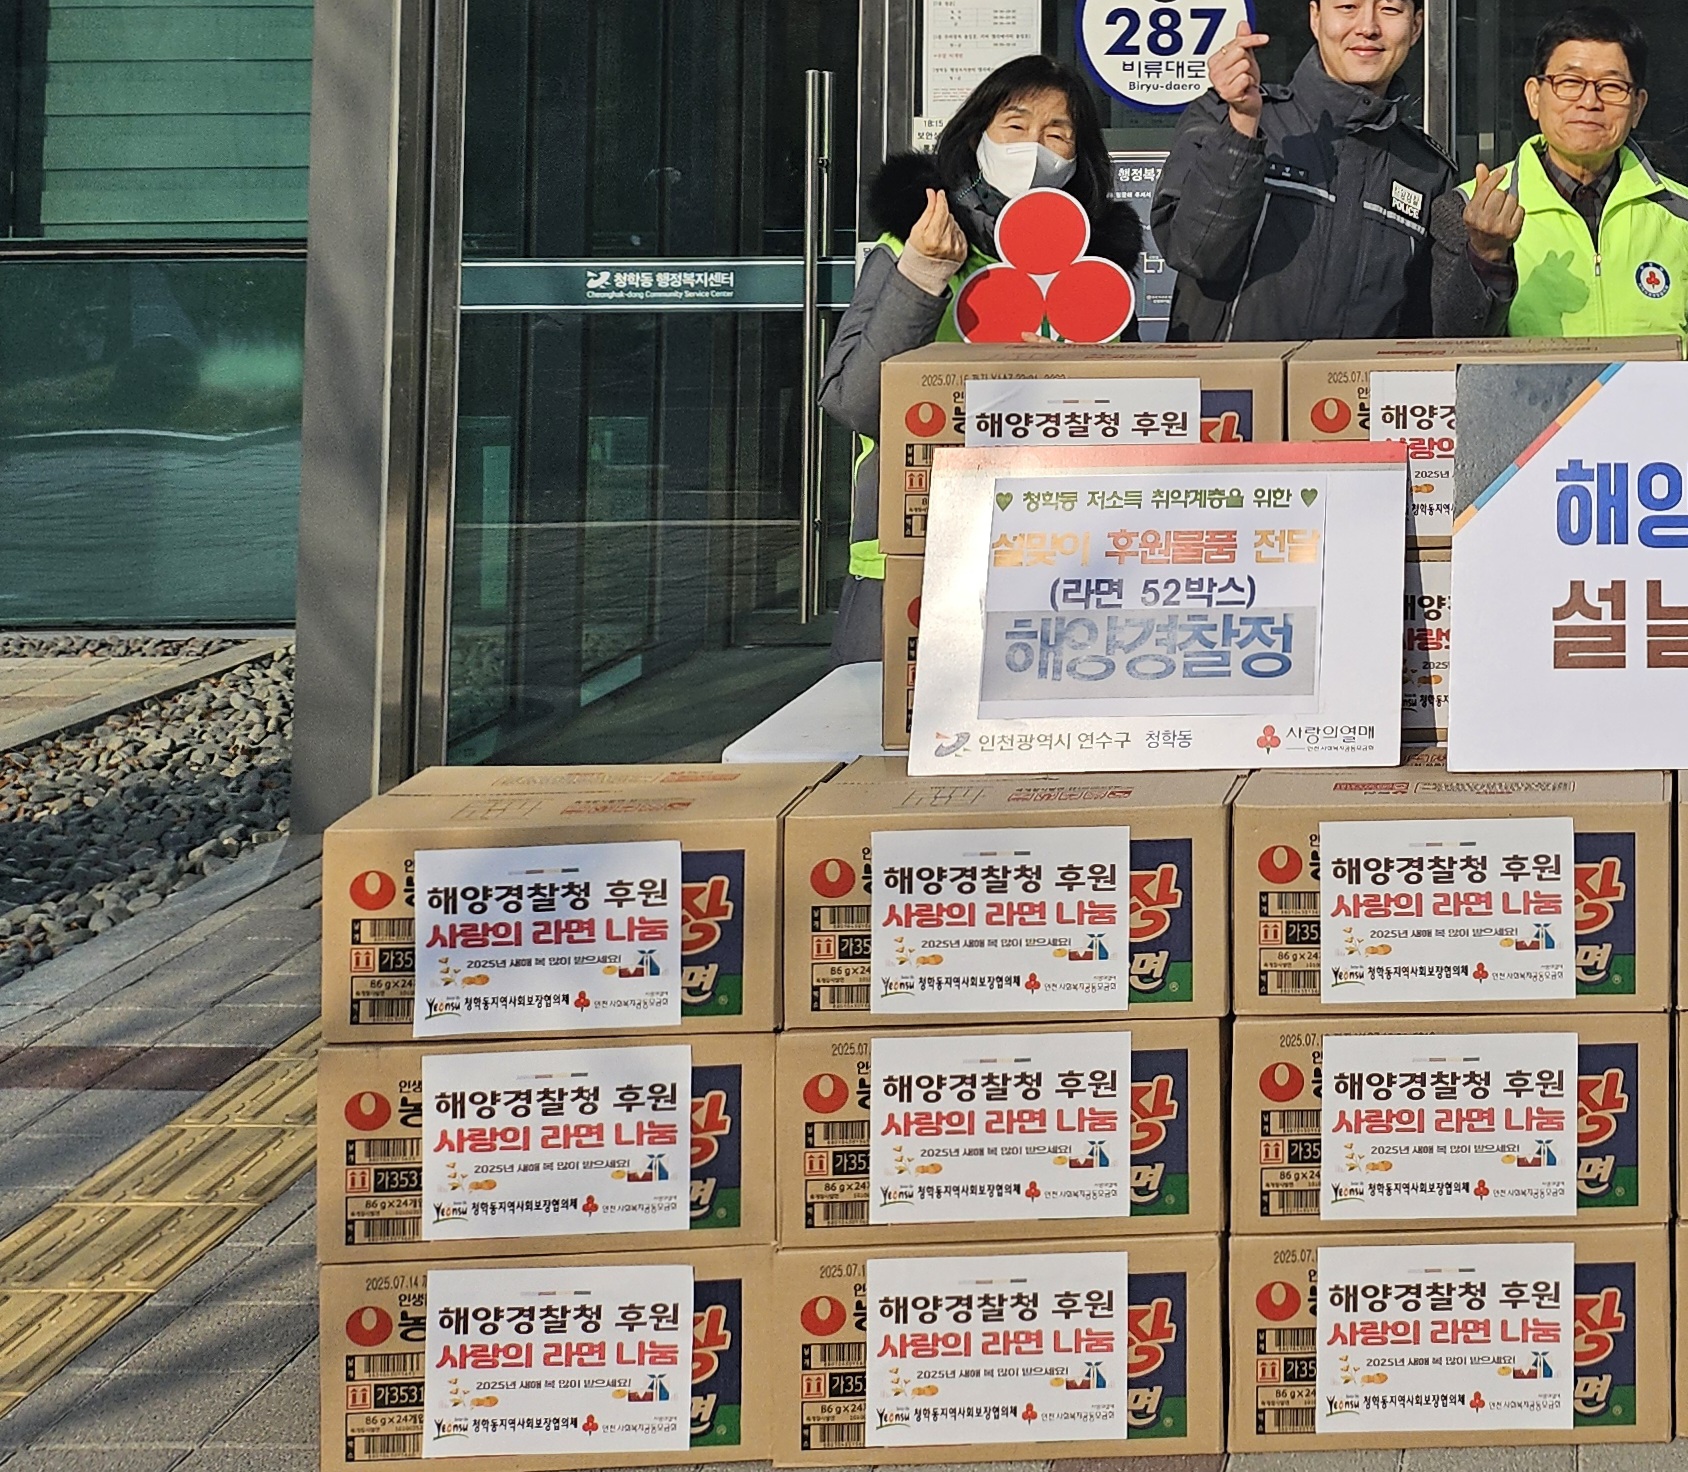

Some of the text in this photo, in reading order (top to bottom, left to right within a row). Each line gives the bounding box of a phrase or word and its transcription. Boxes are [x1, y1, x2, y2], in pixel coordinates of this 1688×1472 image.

[1104, 8, 1226, 56] 287
[1122, 61, 1206, 78] 비류대로
[1129, 81, 1200, 92] Biryu-daero
[1392, 198, 1420, 219] POLICE
[614, 272, 734, 288] 청학동 행정복지센터
[645, 290, 683, 299] Community
[684, 290, 709, 298] Service
[710, 290, 733, 298] Center
[975, 410, 1189, 439] 해양경찰청 후원
[1414, 471, 1449, 479] 2025년
[1022, 488, 1293, 512] 청학동 저소득 취약계층을 위한
[992, 529, 1320, 568] 설맞이 후원물품 전달
[1050, 574, 1256, 612] (라면 52박스)
[978, 729, 1193, 752] 인천광역시 연수구 청학동
[1286, 725, 1374, 744] 사랑의열매
[1330, 853, 1561, 886] 해양경찰청 후원
[425, 878, 667, 916] 해양경찰청 후원
[1330, 890, 1563, 919] 사랑의 라면 나눔
[424, 916, 668, 949] 사랑의 라면 나눔
[366, 1276, 418, 1291] 2025.07.14
[437, 1302, 679, 1336] 해양경찰청 후원
[435, 1340, 679, 1370] 사랑의 라면 나눔
